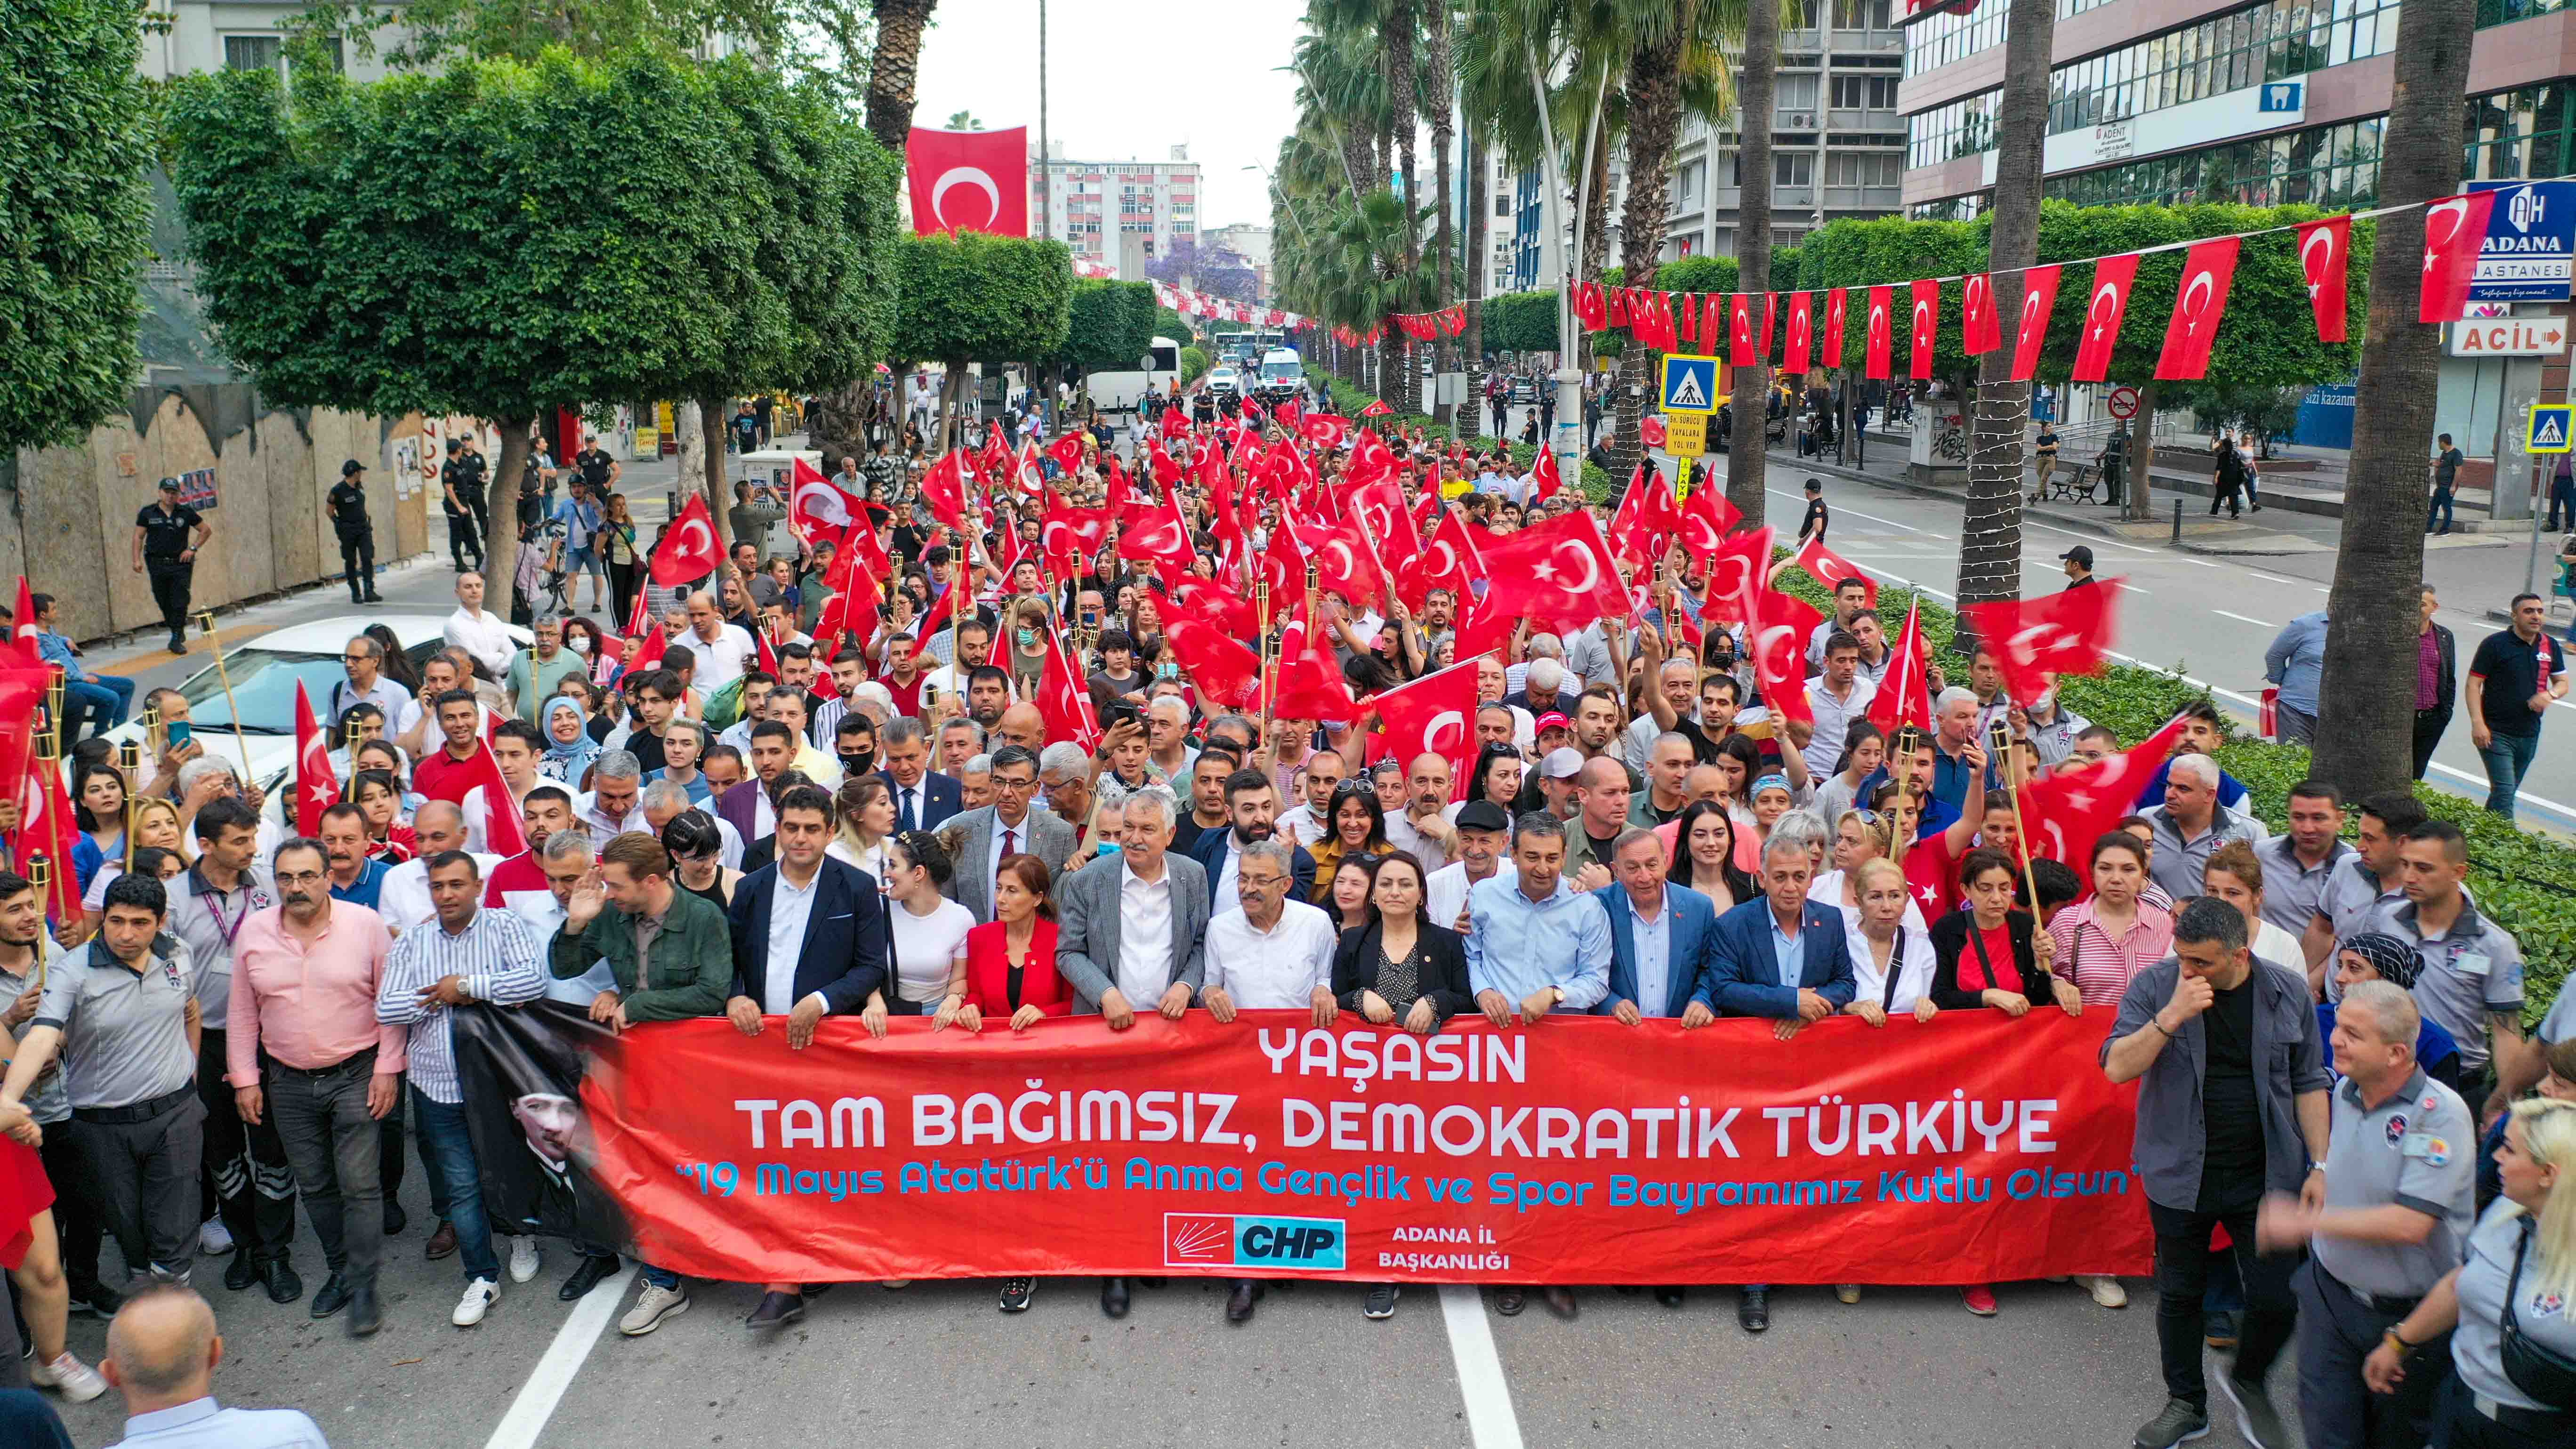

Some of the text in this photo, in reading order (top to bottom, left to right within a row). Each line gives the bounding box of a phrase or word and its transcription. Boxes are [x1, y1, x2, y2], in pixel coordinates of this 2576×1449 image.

[2103, 127, 2125, 139] ADENT
[2480, 236, 2561, 252] ADANA
[2463, 322, 2539, 350] ACİL
[2321, 391, 2355, 406] kazanm
[1672, 428, 1699, 437] YAYALARA
[1674, 441, 1696, 450] YOL VER
[1679, 474, 1687, 496] YAYA
[1259, 1029, 1524, 1092] YAŞASIN
[735, 1079, 2057, 1158] TAM BAĞIMSIZ, DEMOKRATİK TÜRKİYE
[757, 1163, 884, 1201] Mayıs
[1125, 1158, 1242, 1191] Anma
[1258, 1161, 1409, 1207] Gençlik
[1425, 1178, 1473, 1203] ve
[1489, 1173, 1593, 1213] Spor
[1610, 1175, 1861, 1215] Bayramımız
[1878, 1167, 1991, 1203] Kutlu
[1242, 1226, 1335, 1258] CHP
[1393, 1225, 1496, 1244] ADANA İL
[1379, 1251, 1509, 1272] BAŞKANLIĞI
